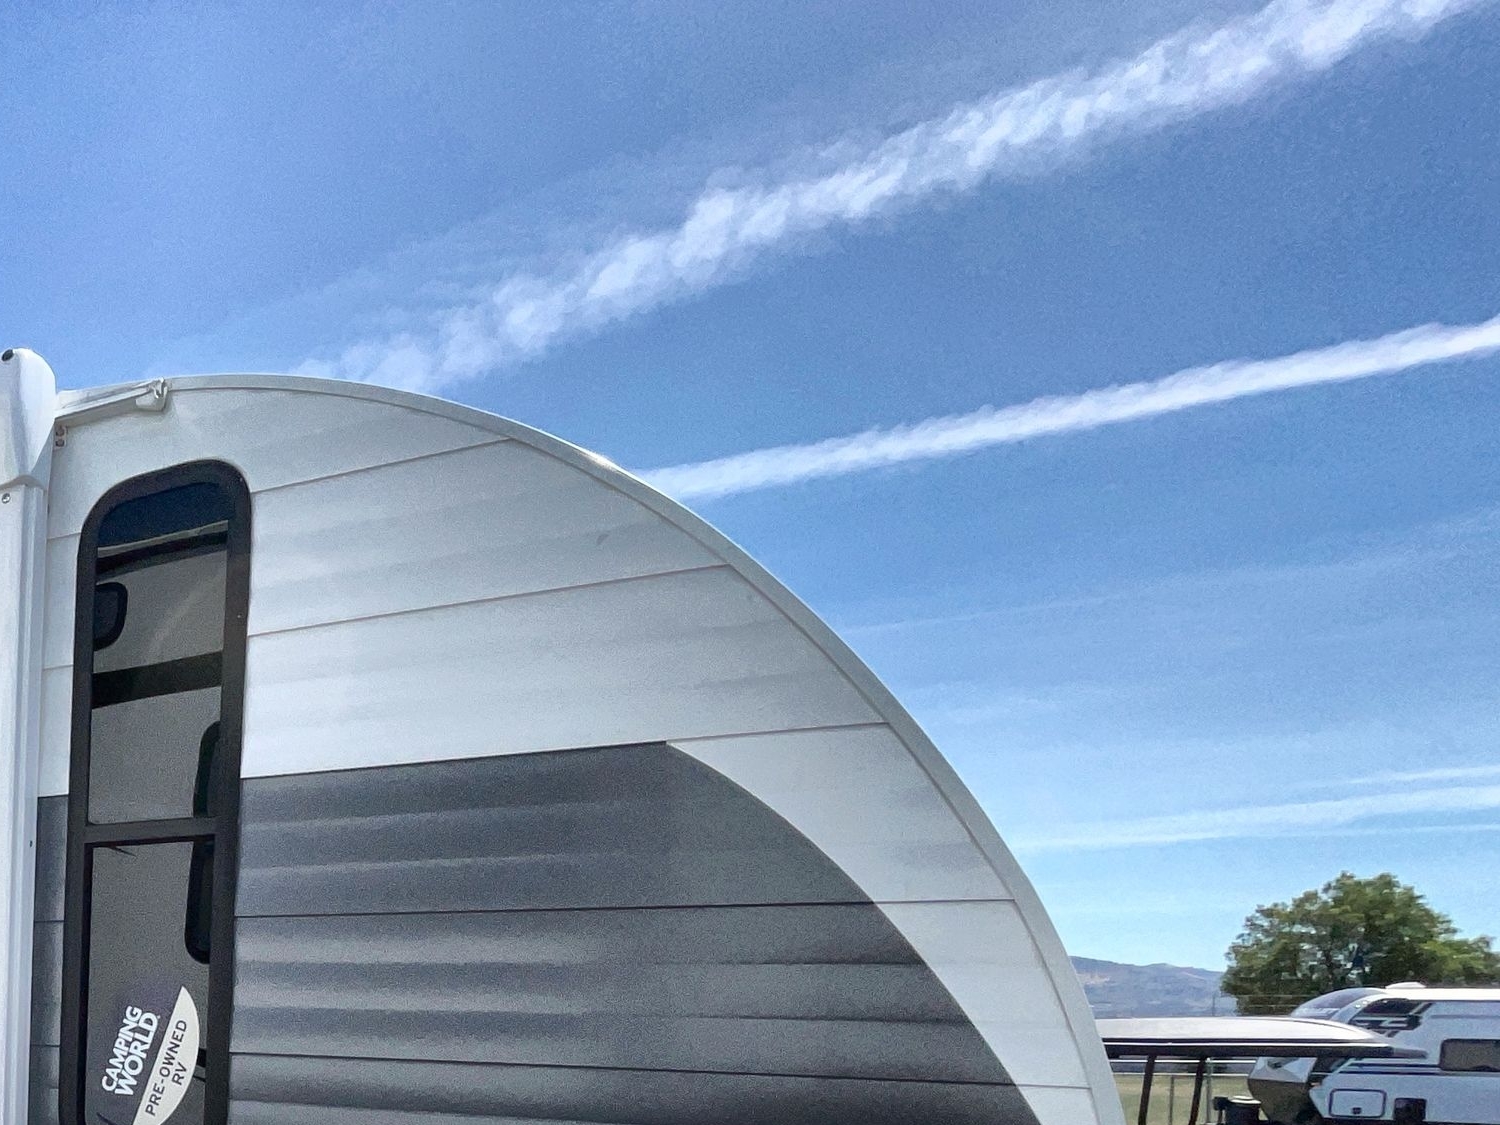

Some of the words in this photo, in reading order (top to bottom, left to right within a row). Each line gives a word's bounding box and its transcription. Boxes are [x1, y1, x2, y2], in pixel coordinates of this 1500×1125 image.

[101, 1005, 142, 1091] CAMPING
[115, 1012, 158, 1095] WORLD
[145, 1019, 187, 1116] PRE-OWNED
[172, 1062, 188, 1086] RV
